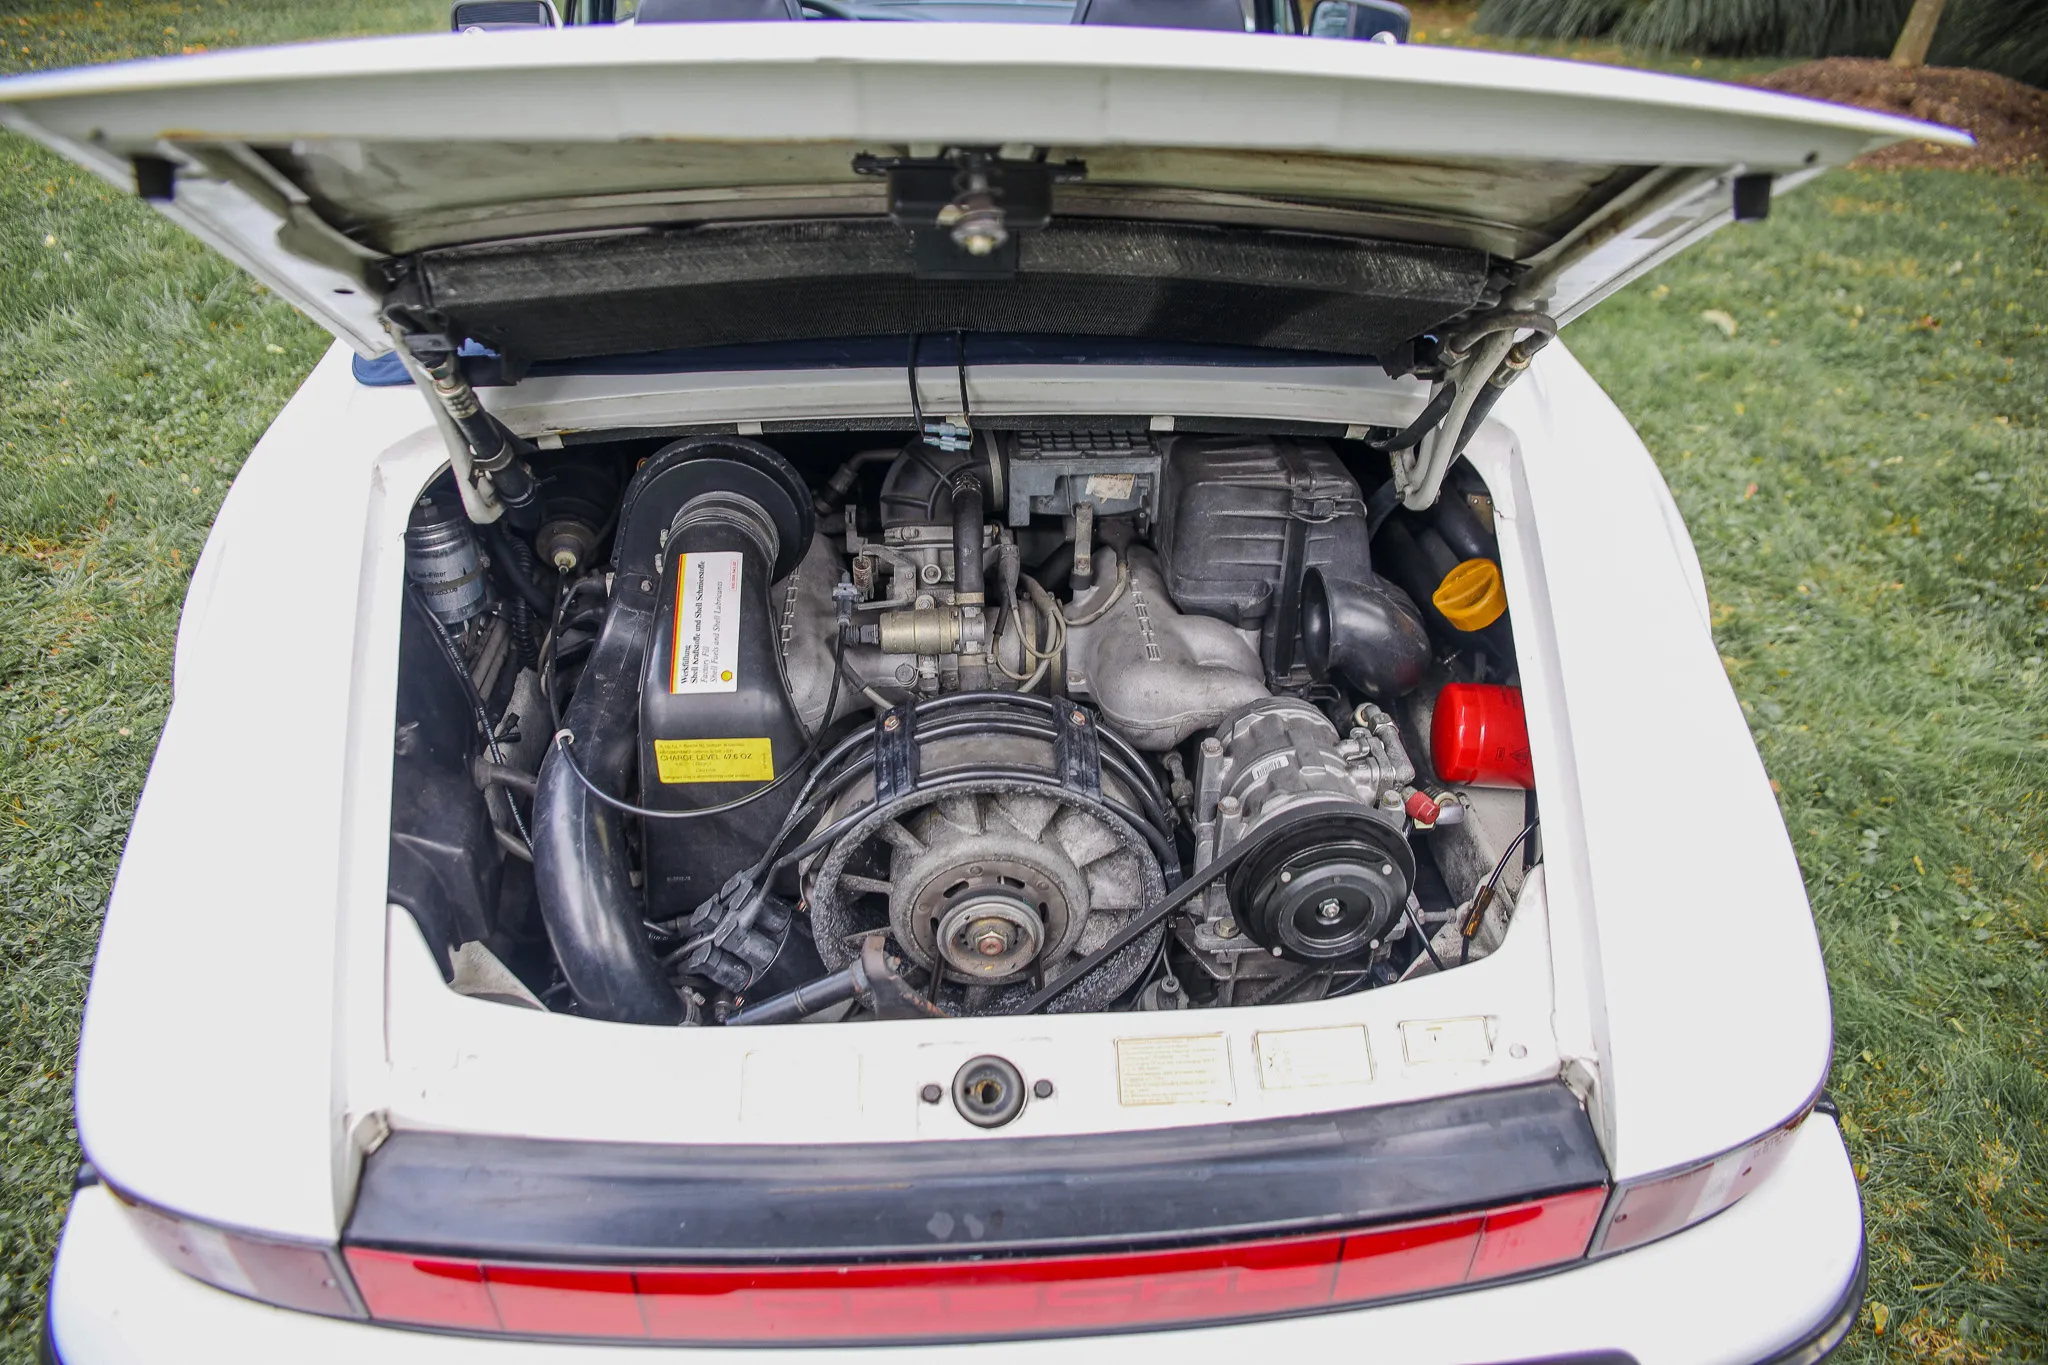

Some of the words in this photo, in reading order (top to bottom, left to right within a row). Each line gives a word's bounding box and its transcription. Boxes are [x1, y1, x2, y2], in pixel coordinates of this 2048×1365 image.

[696, 561, 705, 601] Schmierstoffe
[714, 581, 723, 614] Lubricants
[713, 616, 721, 631] Shell
[692, 633, 701, 664] Kraftstoffe
[711, 647, 719, 664] Fuels
[681, 645, 691, 684] Werkfüllung
[701, 660, 710, 683] Factory
[710, 666, 718, 683] Shell
[740, 752, 752, 760] OZ
